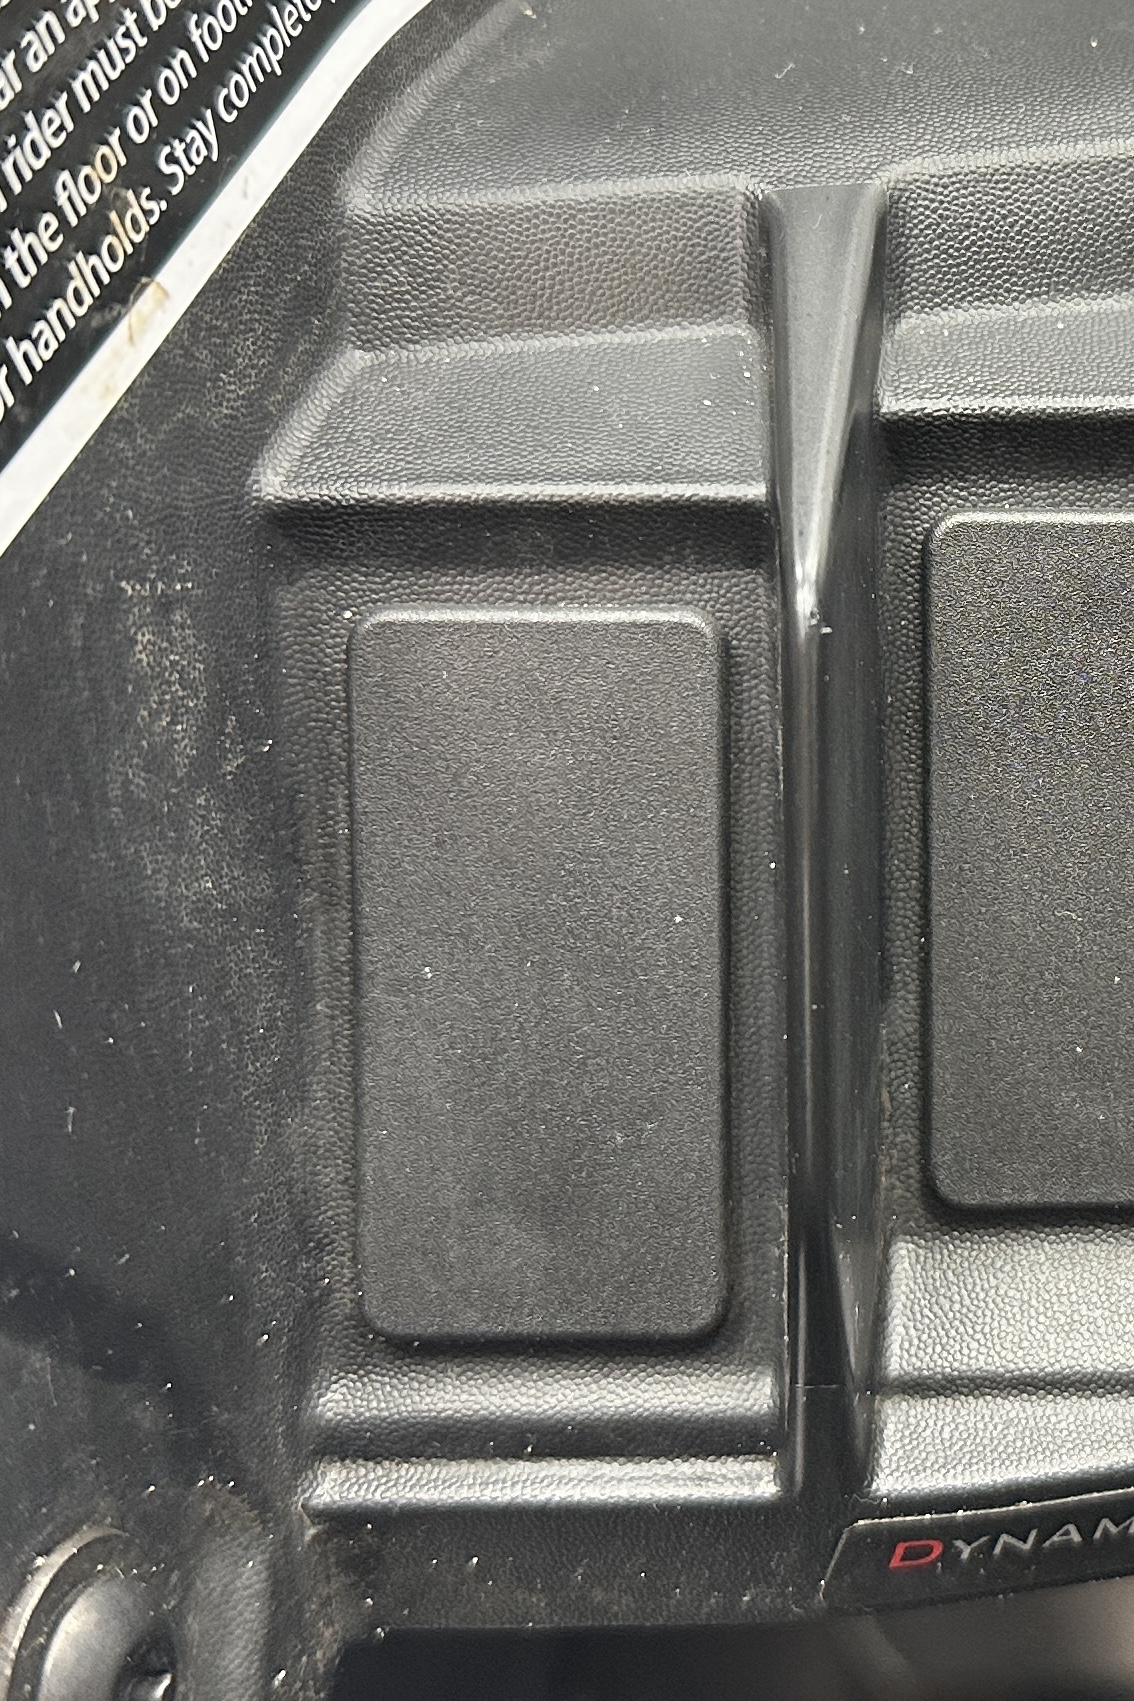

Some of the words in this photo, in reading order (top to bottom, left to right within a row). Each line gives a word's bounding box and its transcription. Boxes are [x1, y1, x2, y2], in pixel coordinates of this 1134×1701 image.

[1, 90, 75, 196] rider
[70, 6, 148, 114] must
[19, 10, 66, 73] an
[3, 211, 65, 289] the
[54, 126, 128, 228] floor
[126, 89, 159, 145] or
[156, 48, 198, 106] on
[5, 186, 169, 386] handholds.
[157, 108, 219, 195] Stay
